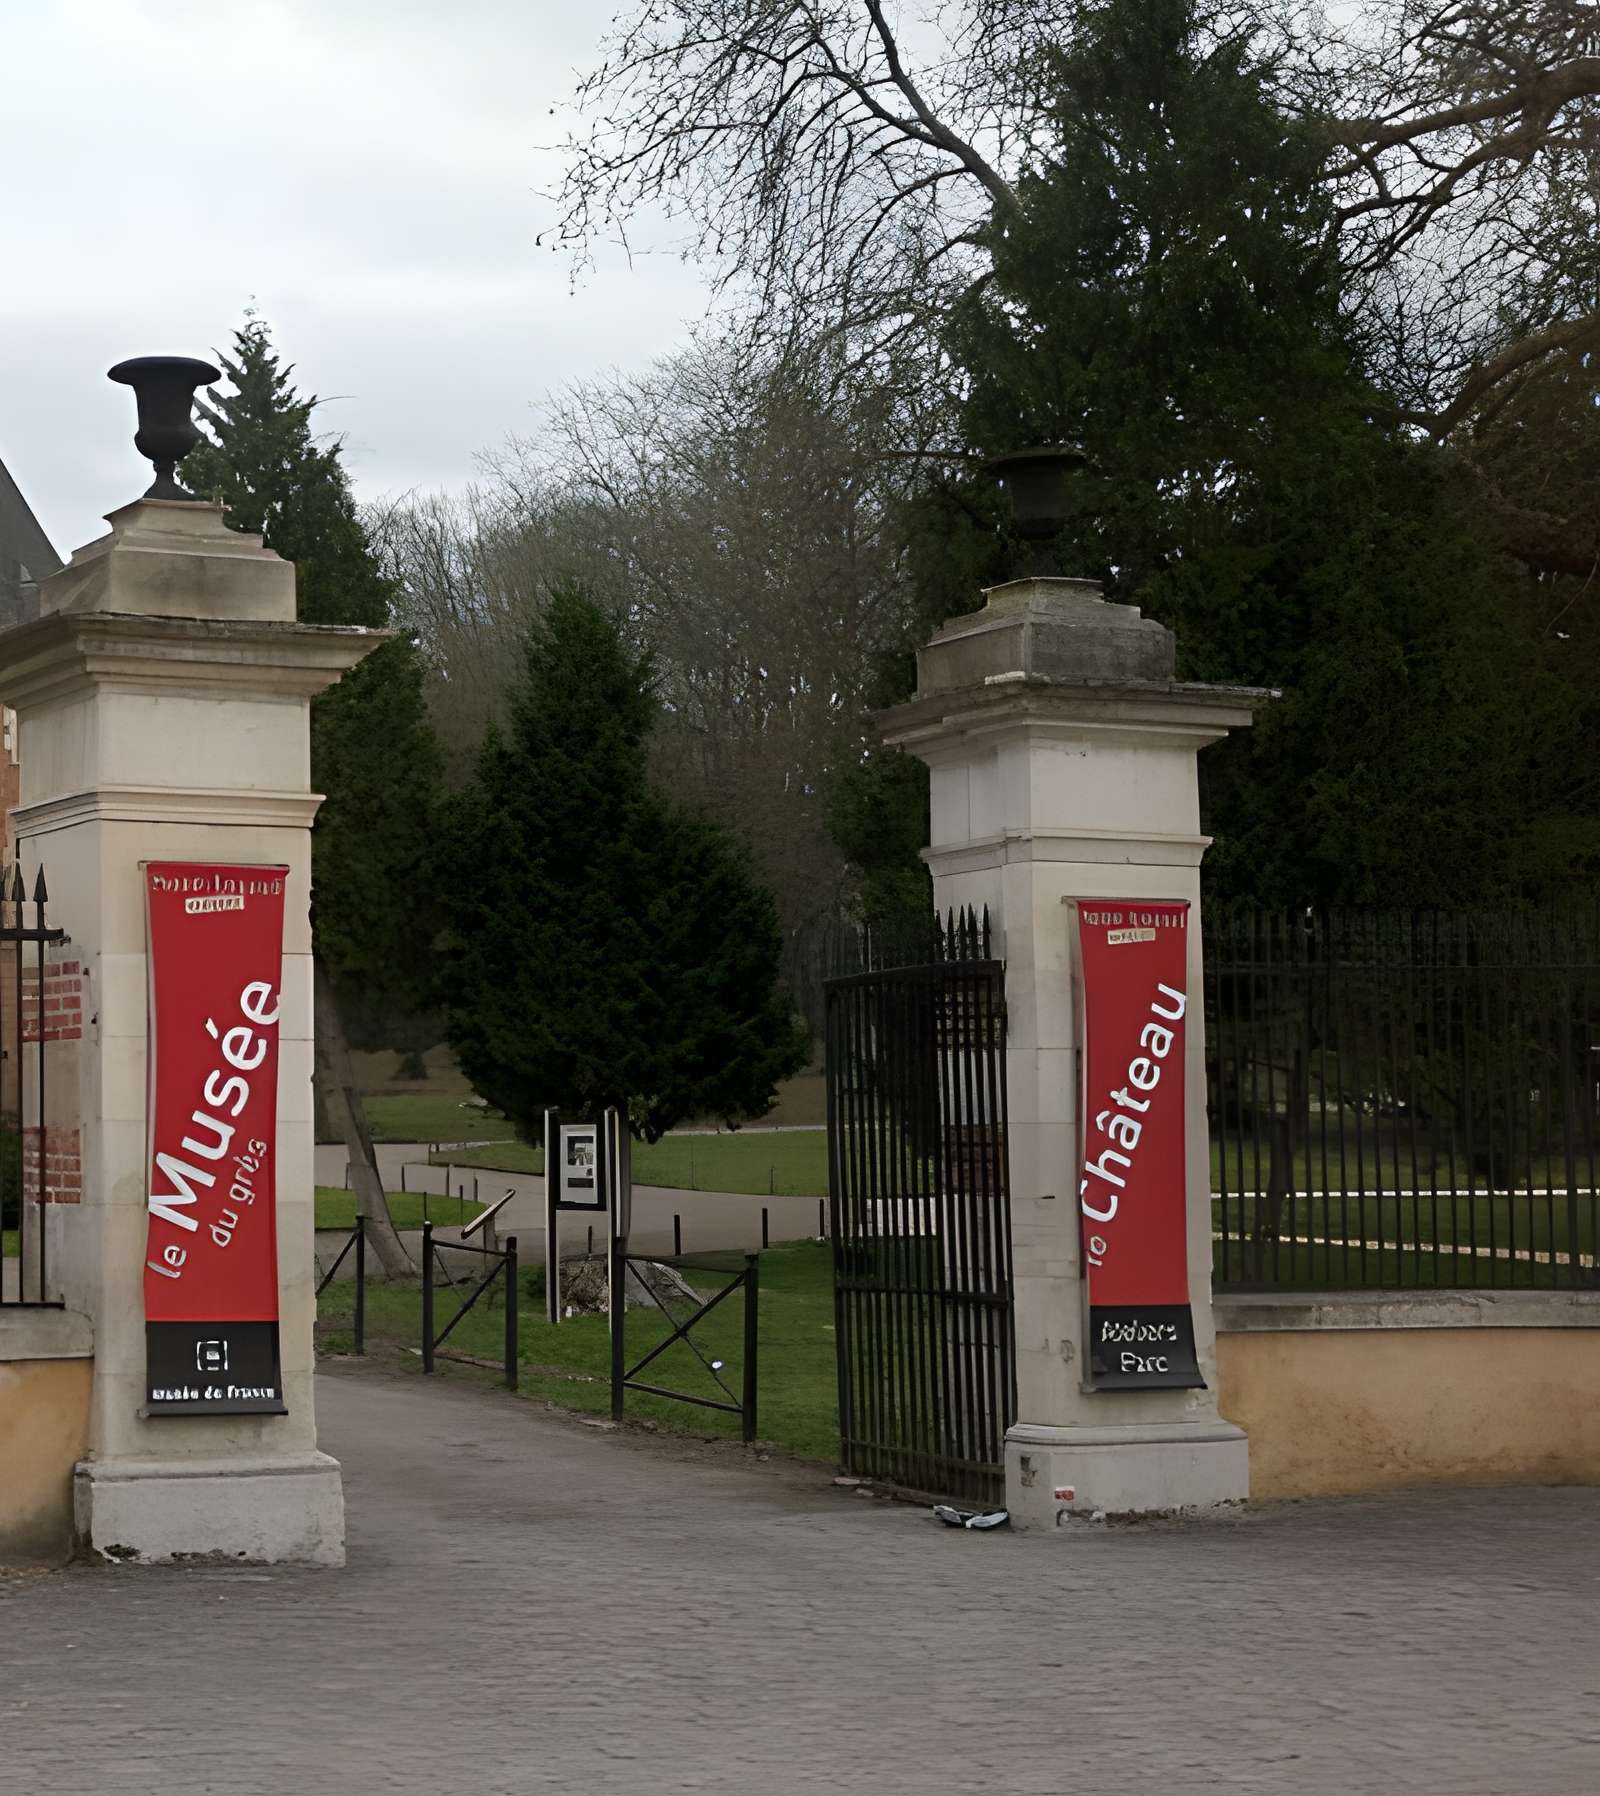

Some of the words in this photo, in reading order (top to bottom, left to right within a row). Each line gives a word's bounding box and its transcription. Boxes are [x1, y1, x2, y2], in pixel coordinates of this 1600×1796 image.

[148, 979, 282, 1233] Musée
[1081, 981, 1188, 1224] Château
[208, 1207, 239, 1248] du
